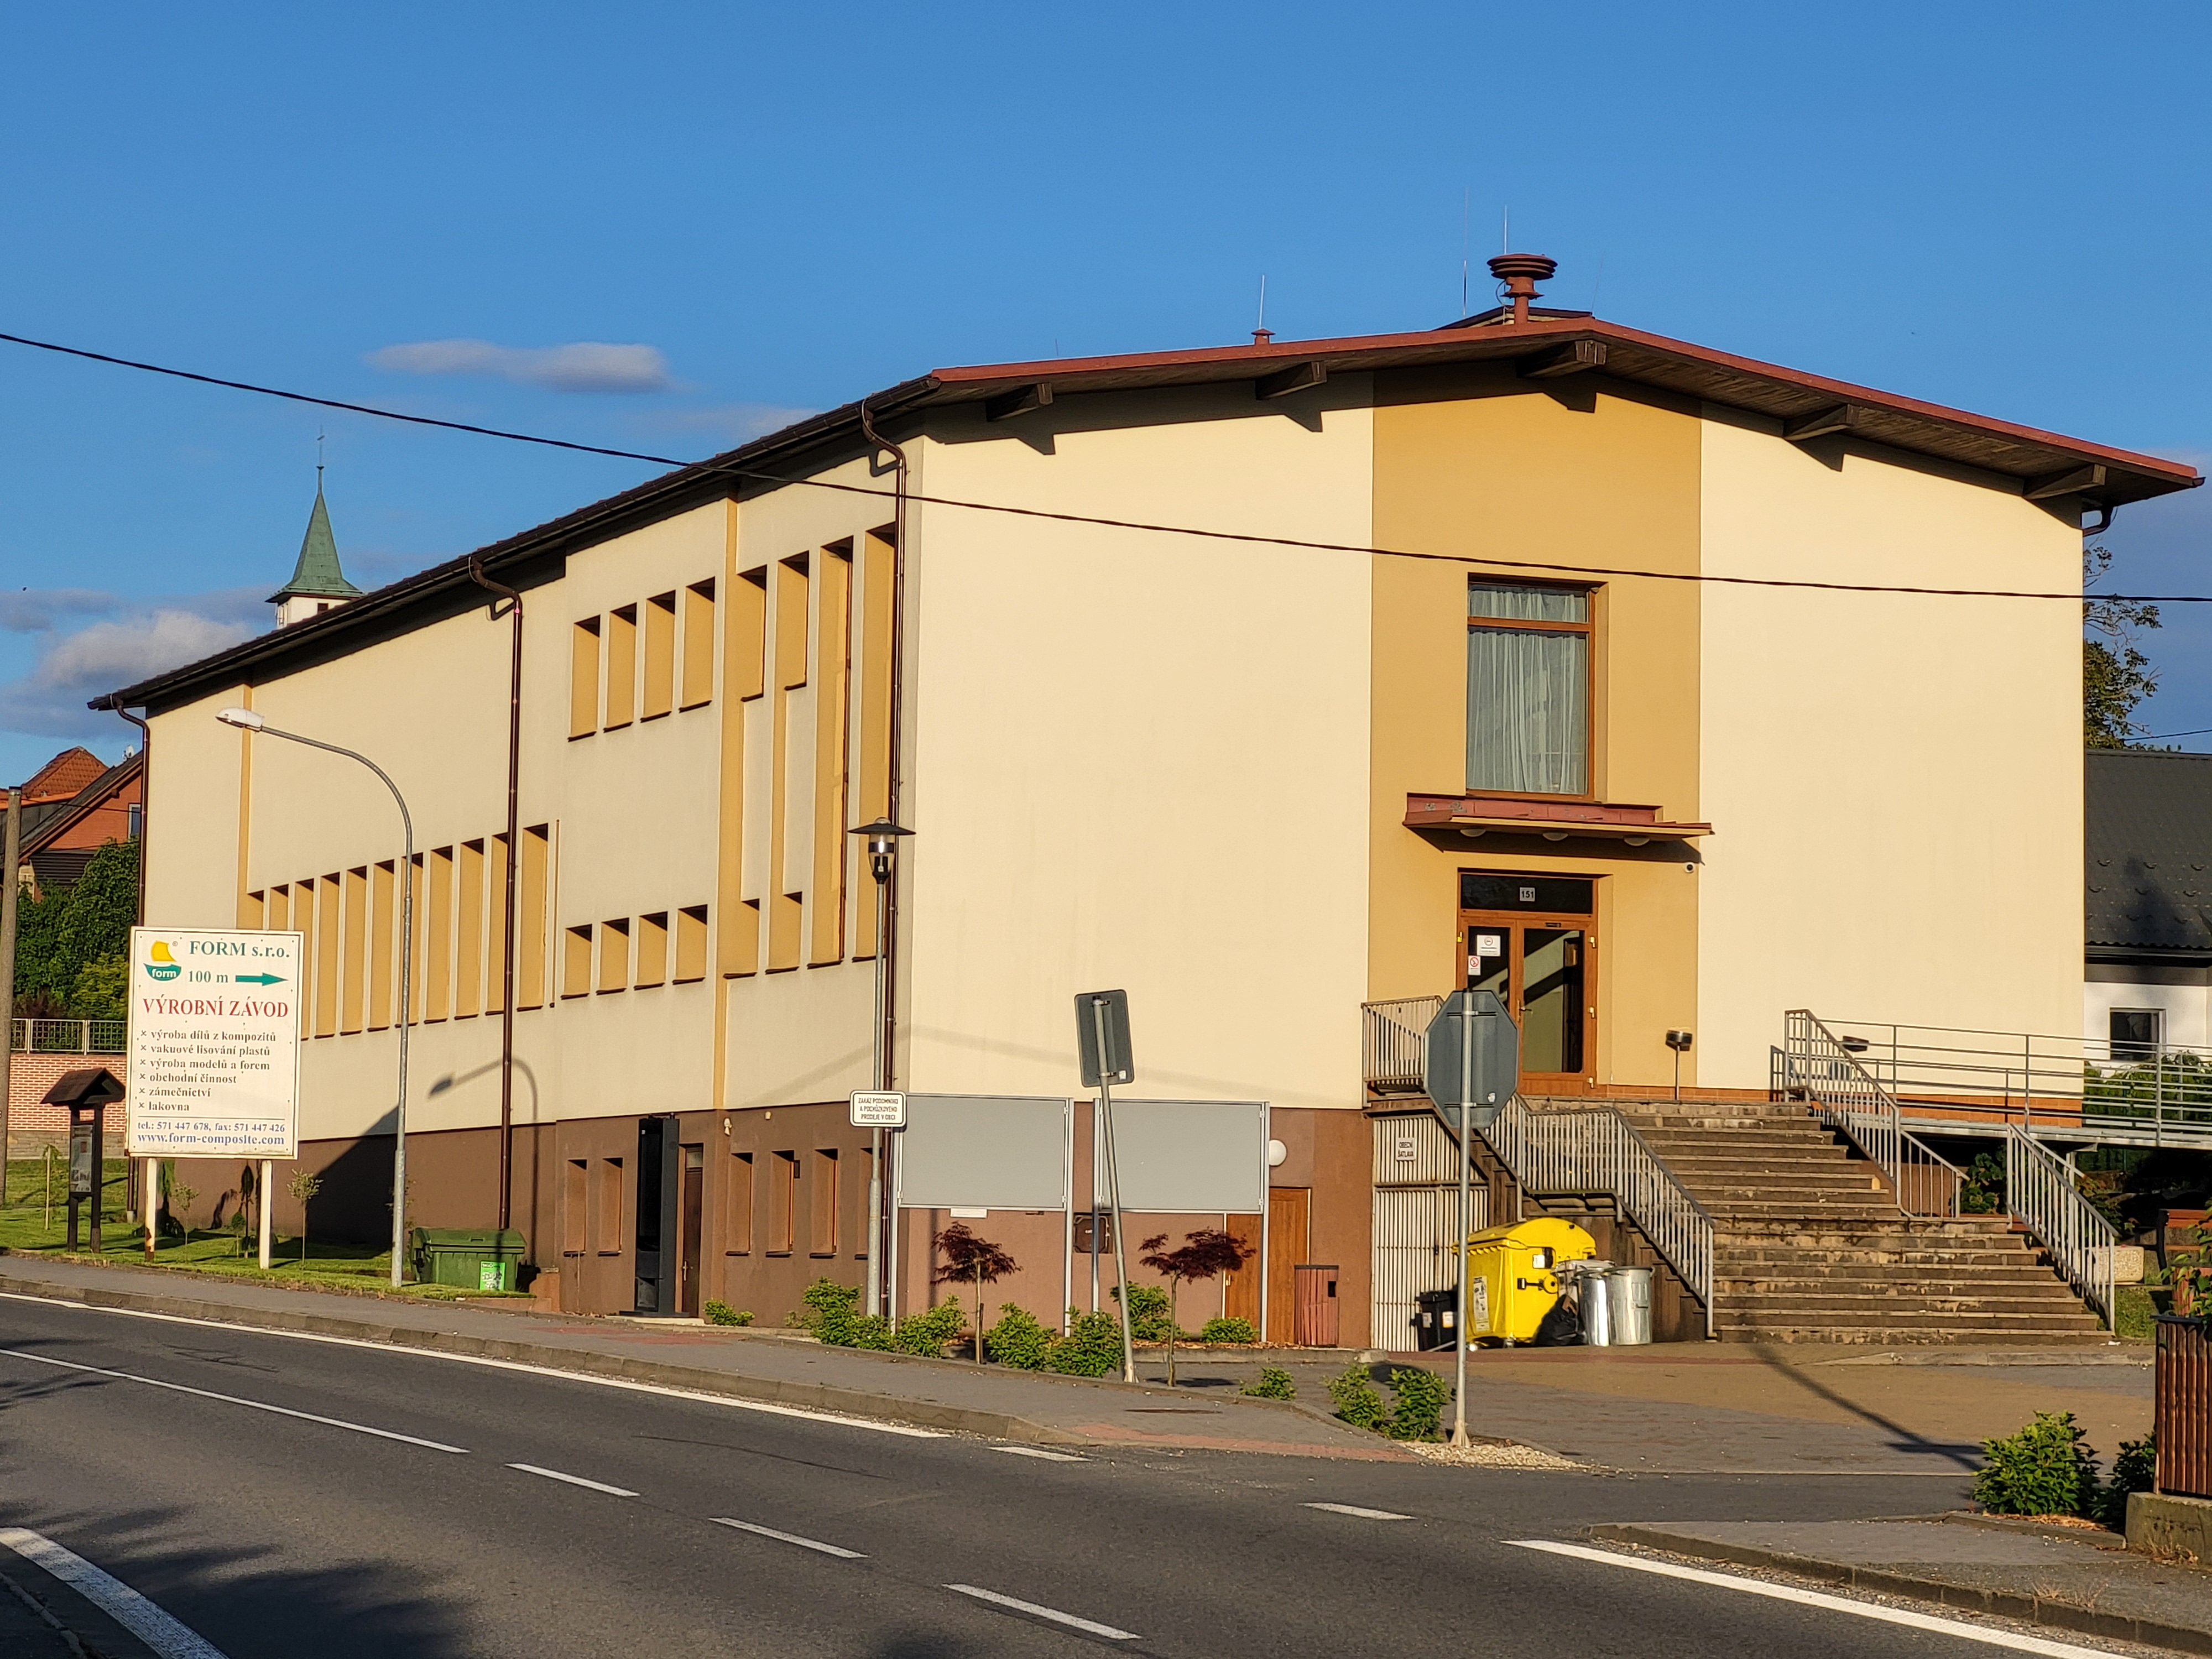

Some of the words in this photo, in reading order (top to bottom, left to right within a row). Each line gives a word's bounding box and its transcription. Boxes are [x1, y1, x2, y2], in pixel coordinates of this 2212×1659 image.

[190, 941, 246, 956] FORM
[252, 945, 290, 958] s.r.o.
[152, 969, 176, 978] form
[189, 971, 211, 982] 100
[216, 973, 228, 983] m
[143, 994, 225, 1015] VÝROBNÍ
[229, 997, 288, 1017] ZÁVOD
[151, 1030, 186, 1040] výroba
[190, 1030, 210, 1040] dílů
[222, 1031, 276, 1042] kompozitů
[150, 1045, 194, 1053] vakuové
[197, 1045, 236, 1055] lisování
[239, 1046, 270, 1057] plastů
[150, 1058, 186, 1069] výroba
[189, 1060, 227, 1069] modelů
[241, 1061, 269, 1070] forem
[150, 1073, 197, 1082] obchodní
[200, 1074, 237, 1083] činnost
[149, 1087, 211, 1097] zámečnictví
[149, 1102, 189, 1111] lakovna
[194, 1123, 211, 1131] 678,
[138, 1133, 284, 1145] www.form-composite.com
